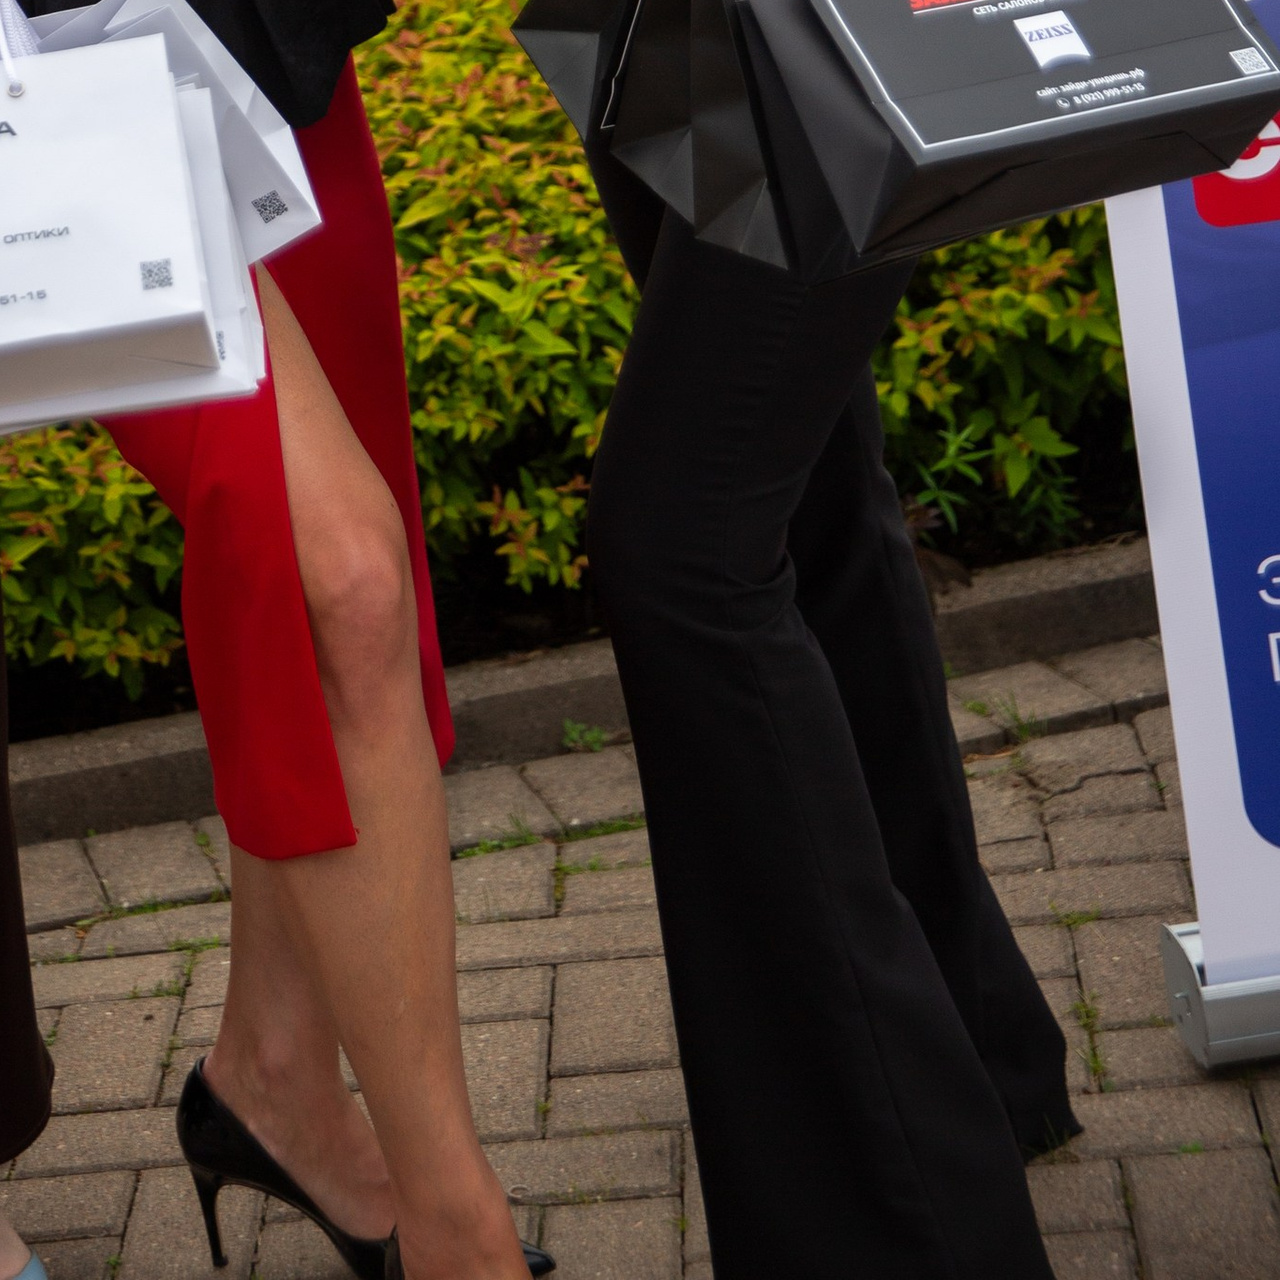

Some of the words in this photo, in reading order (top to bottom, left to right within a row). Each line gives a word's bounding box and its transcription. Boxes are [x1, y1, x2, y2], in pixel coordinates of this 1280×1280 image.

[973, 3, 998, 15] СЕТЬ
[1024, 24, 1074, 42] ZEISS
[1080, 90, 1105, 104] (921)
[1102, 82, 1145, 98] 999-51-15
[3, 226, 70, 244] ОПТИКИ
